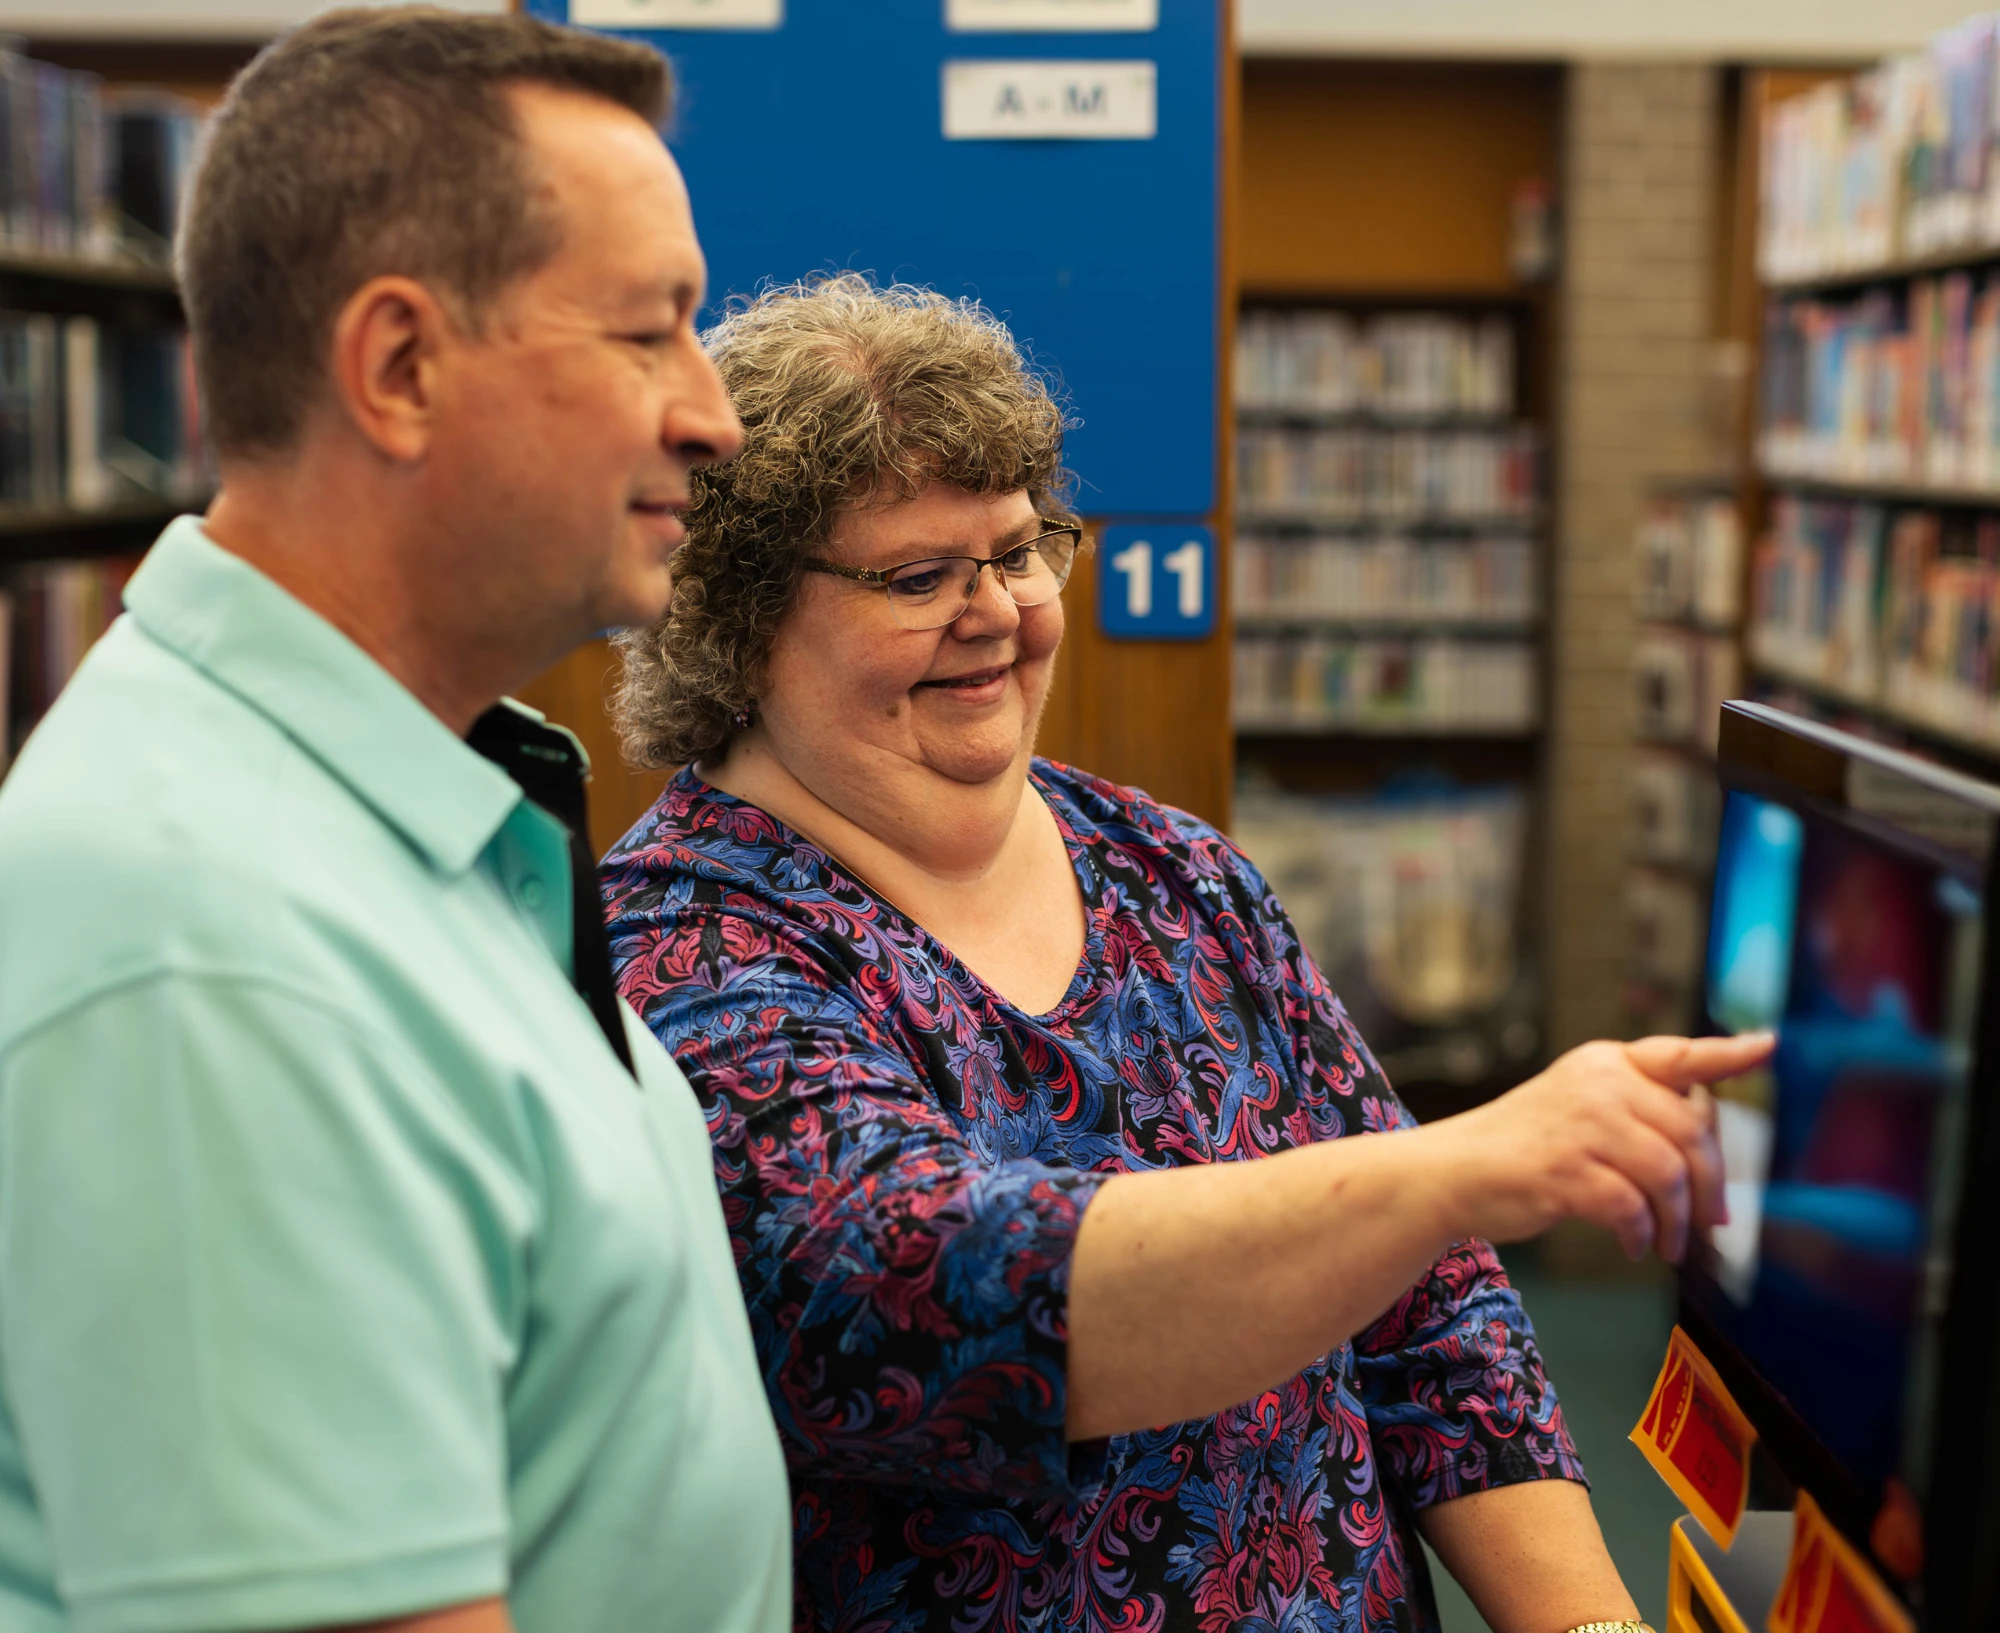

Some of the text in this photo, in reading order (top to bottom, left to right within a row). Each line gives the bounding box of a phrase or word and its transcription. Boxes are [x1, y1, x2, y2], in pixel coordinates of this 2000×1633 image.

[993, 82, 1026, 119] A
[1063, 82, 1107, 119] M
[1112, 540, 1203, 618] 11
